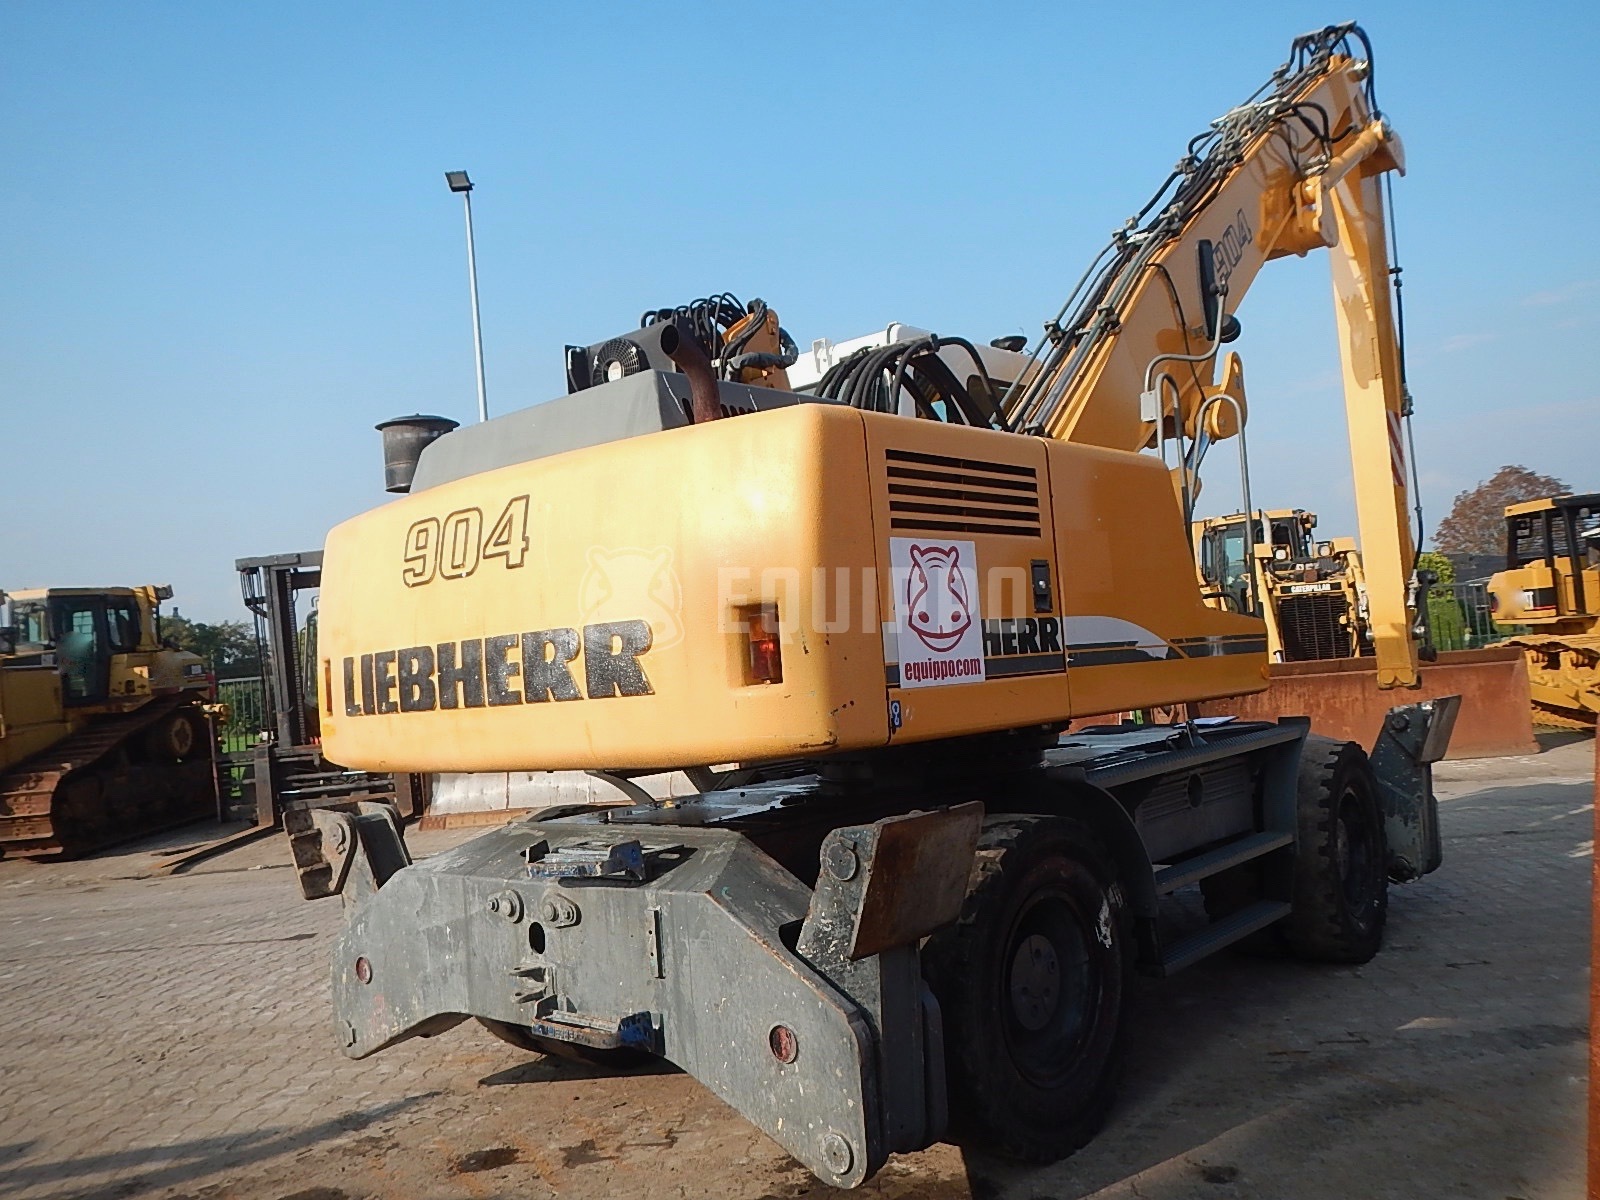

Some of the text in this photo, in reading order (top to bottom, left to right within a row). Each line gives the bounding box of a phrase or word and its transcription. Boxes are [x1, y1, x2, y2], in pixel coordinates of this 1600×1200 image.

[403, 494, 530, 587] 904
[343, 619, 656, 717] LIEBHERR
[904, 657, 982, 682] equippo.com
